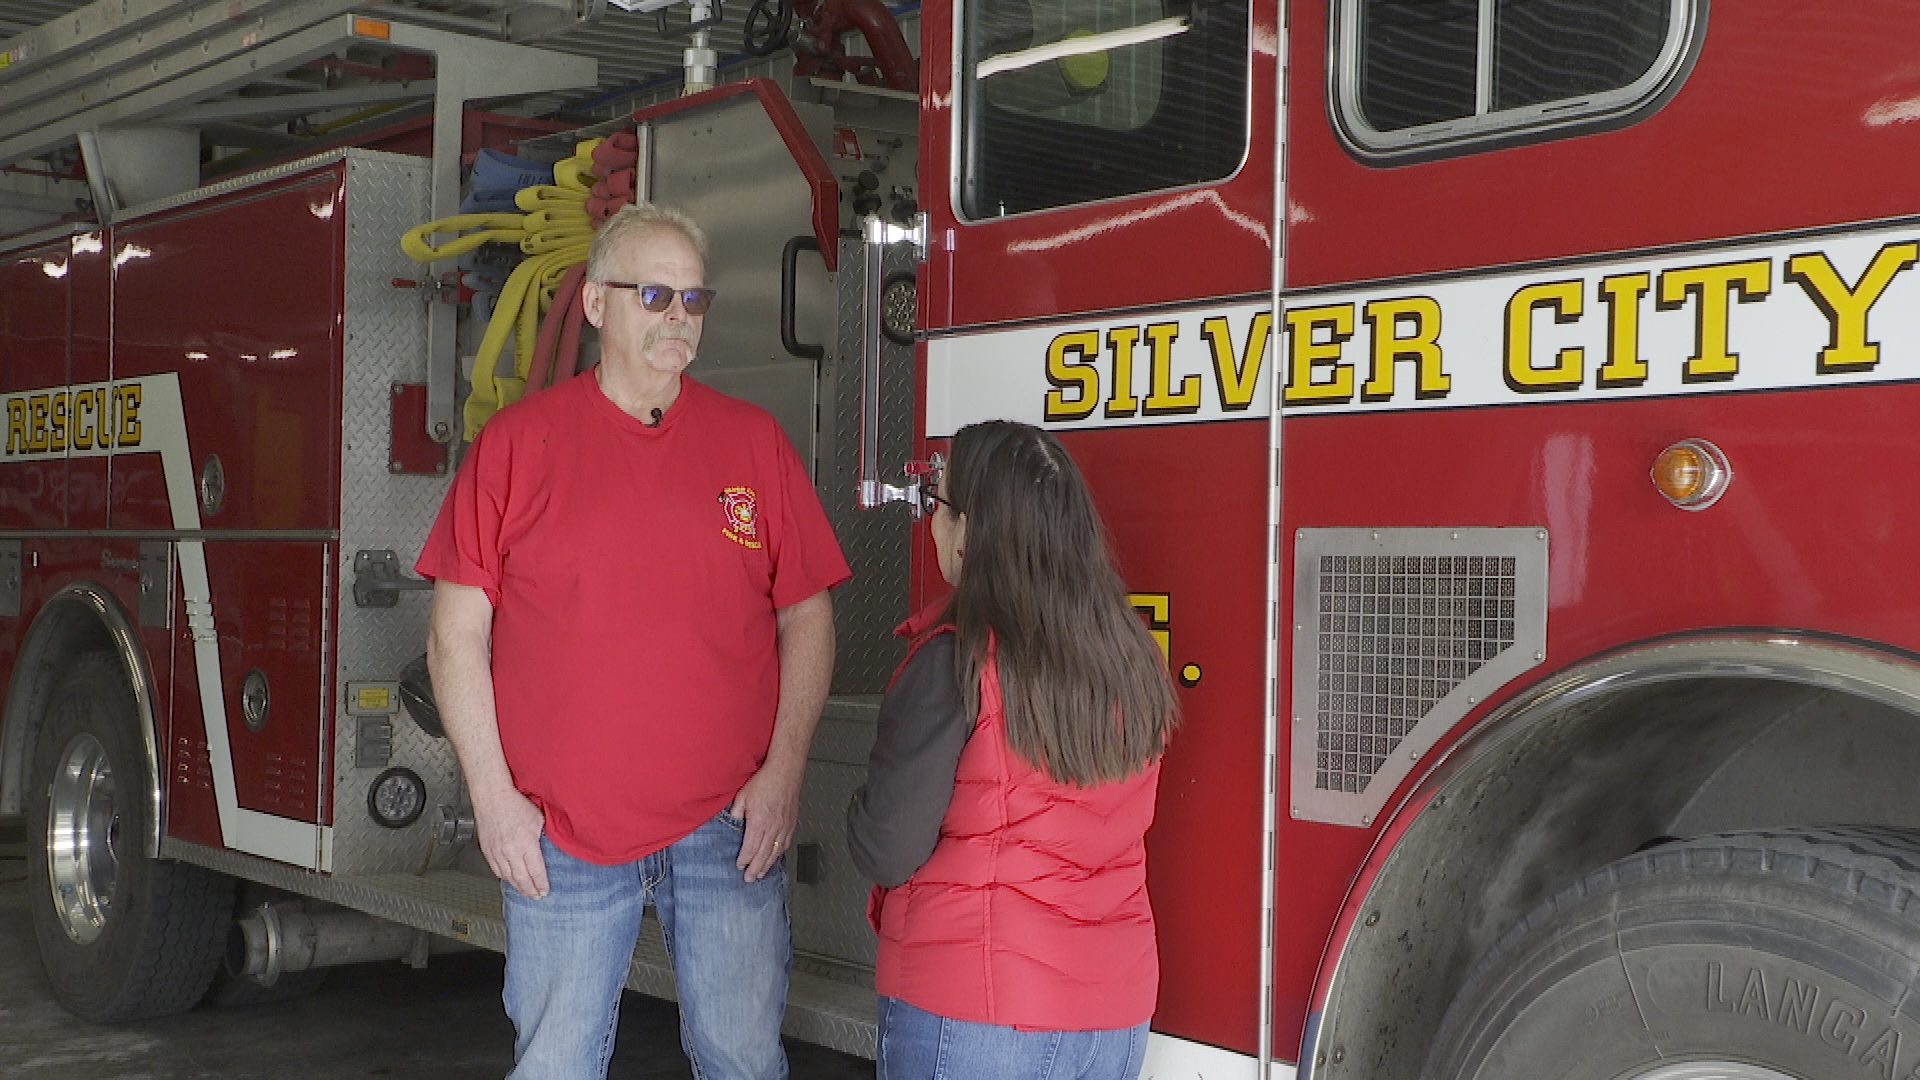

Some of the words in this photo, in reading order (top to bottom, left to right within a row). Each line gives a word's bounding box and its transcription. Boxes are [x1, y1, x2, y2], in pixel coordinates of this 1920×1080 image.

[1044, 295, 1452, 422] SILVER
[1502, 239, 1920, 394] CITY
[6, 384, 141, 455] RESCUE
[1707, 961, 1920, 1080] LANGA
